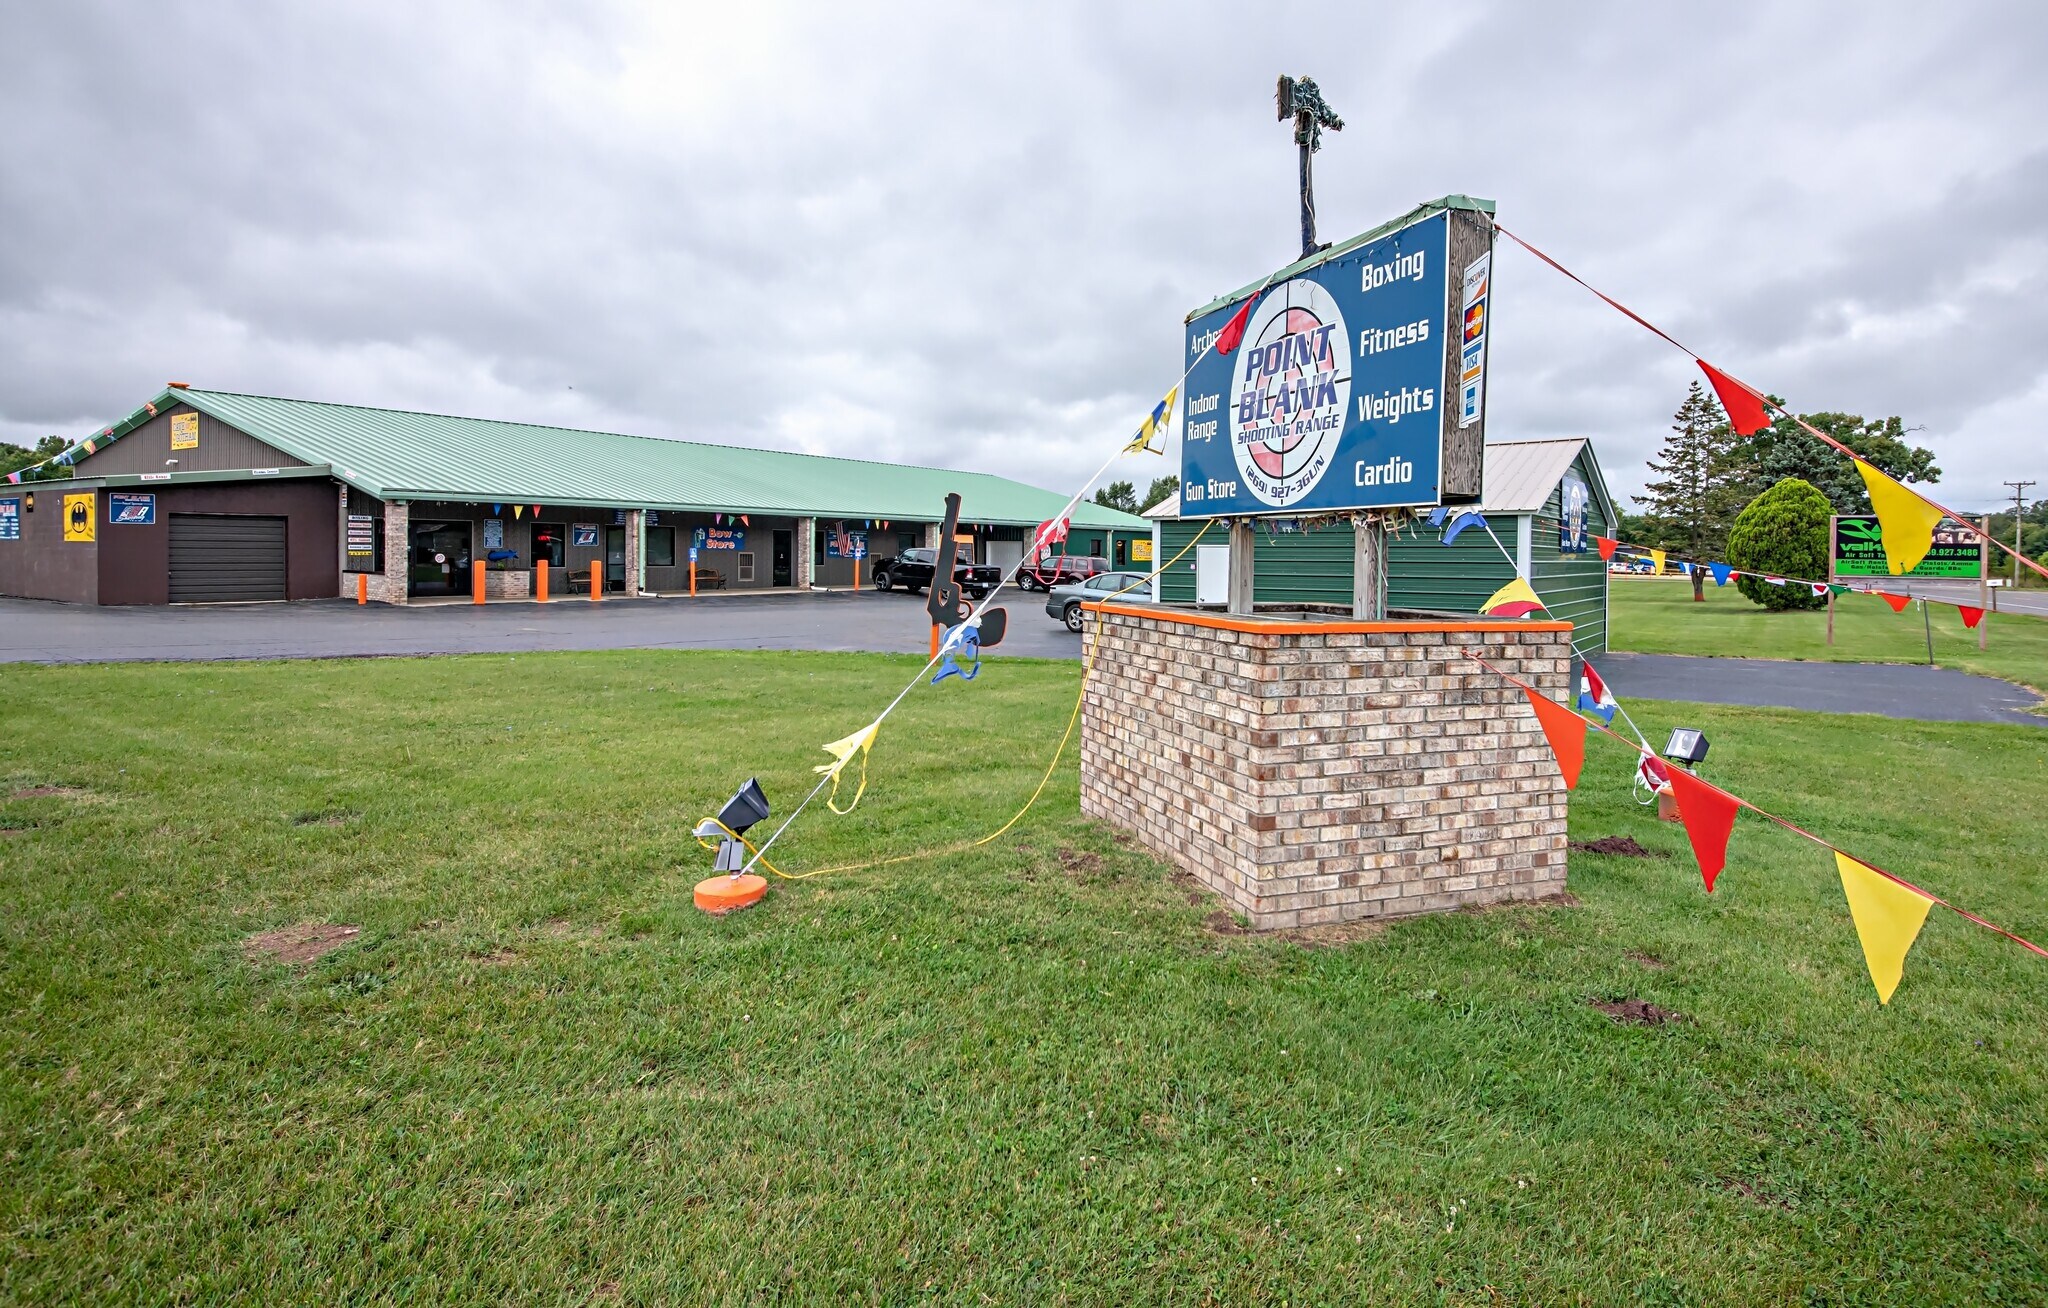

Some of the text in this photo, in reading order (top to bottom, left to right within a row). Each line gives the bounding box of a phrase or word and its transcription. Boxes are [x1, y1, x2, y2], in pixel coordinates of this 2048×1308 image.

[1362, 250, 1425, 292] Boxing
[1360, 318, 1430, 357] Fitness
[1245, 323, 1337, 383] POINT
[1465, 354, 1478, 371] VISA
[1188, 393, 1220, 417] Indoor
[1237, 369, 1340, 425] BLANK
[1357, 387, 1434, 424] Weights
[1187, 420, 1218, 443] Range
[1237, 414, 1340, 446] SHOOTING RANGE
[1246, 465, 1268, 494] (269)
[1354, 455, 1413, 487] Cardio
[1185, 478, 1237, 502] Gun Store
[706, 538, 736, 550] Store
[708, 527, 733, 538] Bow
[1839, 541, 1885, 552] valk
